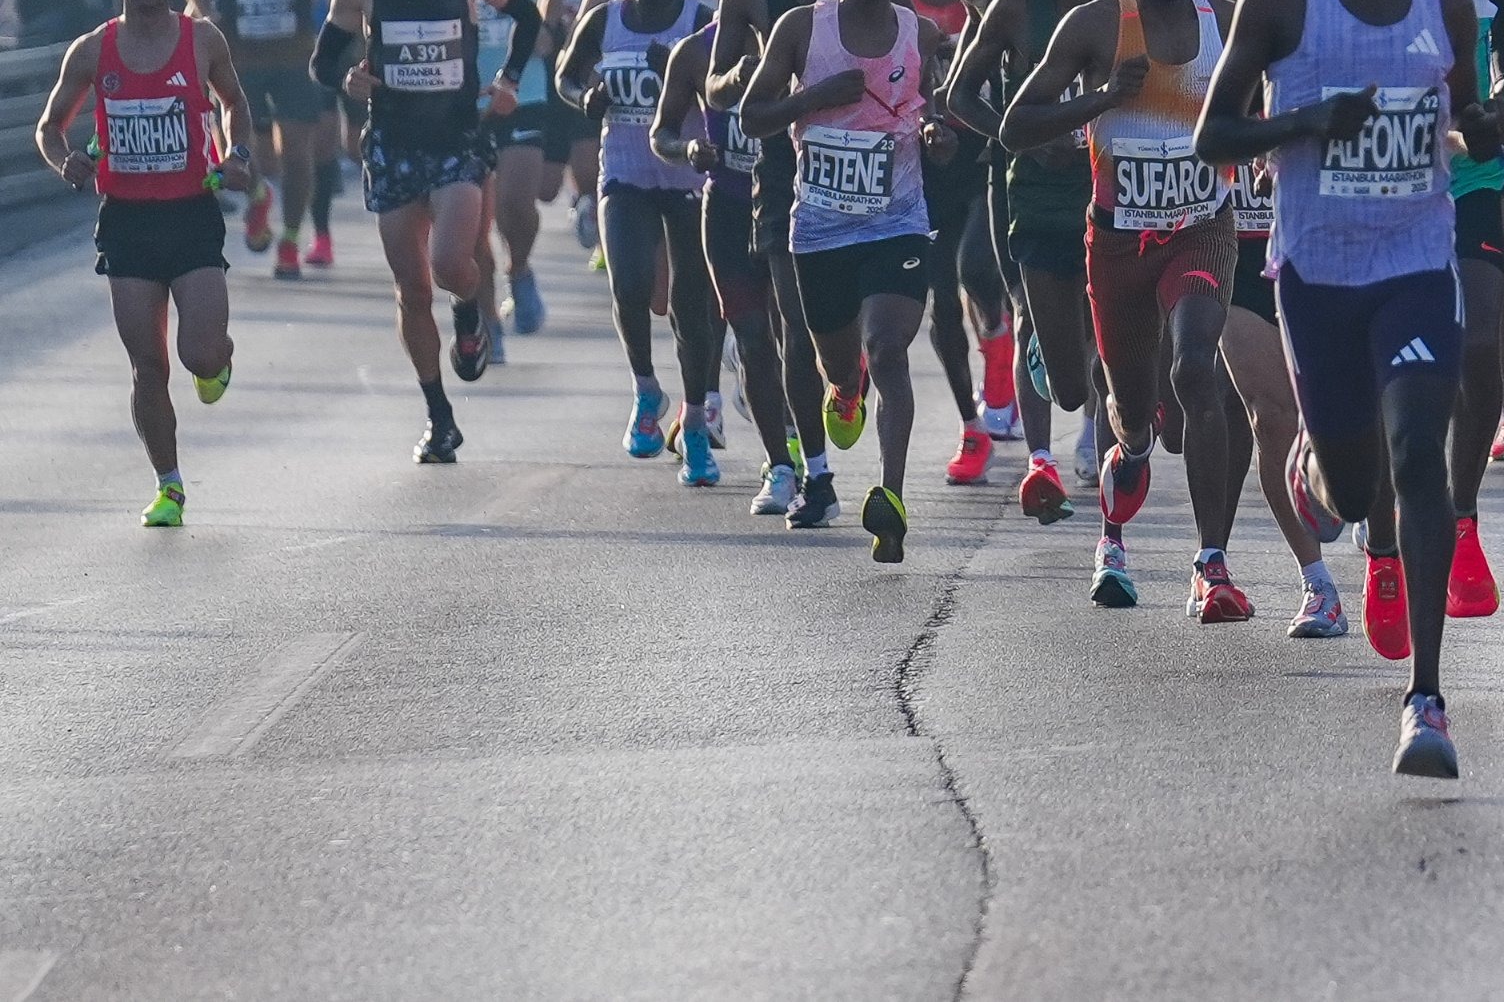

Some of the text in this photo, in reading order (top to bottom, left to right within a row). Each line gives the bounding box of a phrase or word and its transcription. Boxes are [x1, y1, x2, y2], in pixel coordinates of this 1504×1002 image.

[399, 43, 447, 63] A 391
[107, 113, 188, 155] BEKIRHAN
[1325, 113, 1436, 169] ALFONCE
[881, 139, 895, 150] 23
[807, 144, 887, 194] FETENE
[1331, 169, 1426, 182] ISTANBUL MARATHON
[1117, 160, 1215, 207] SUFARO
[809, 186, 883, 205] ISTANBUL MARATHON
[1124, 203, 1209, 219] ISTANBUL MARATHON
